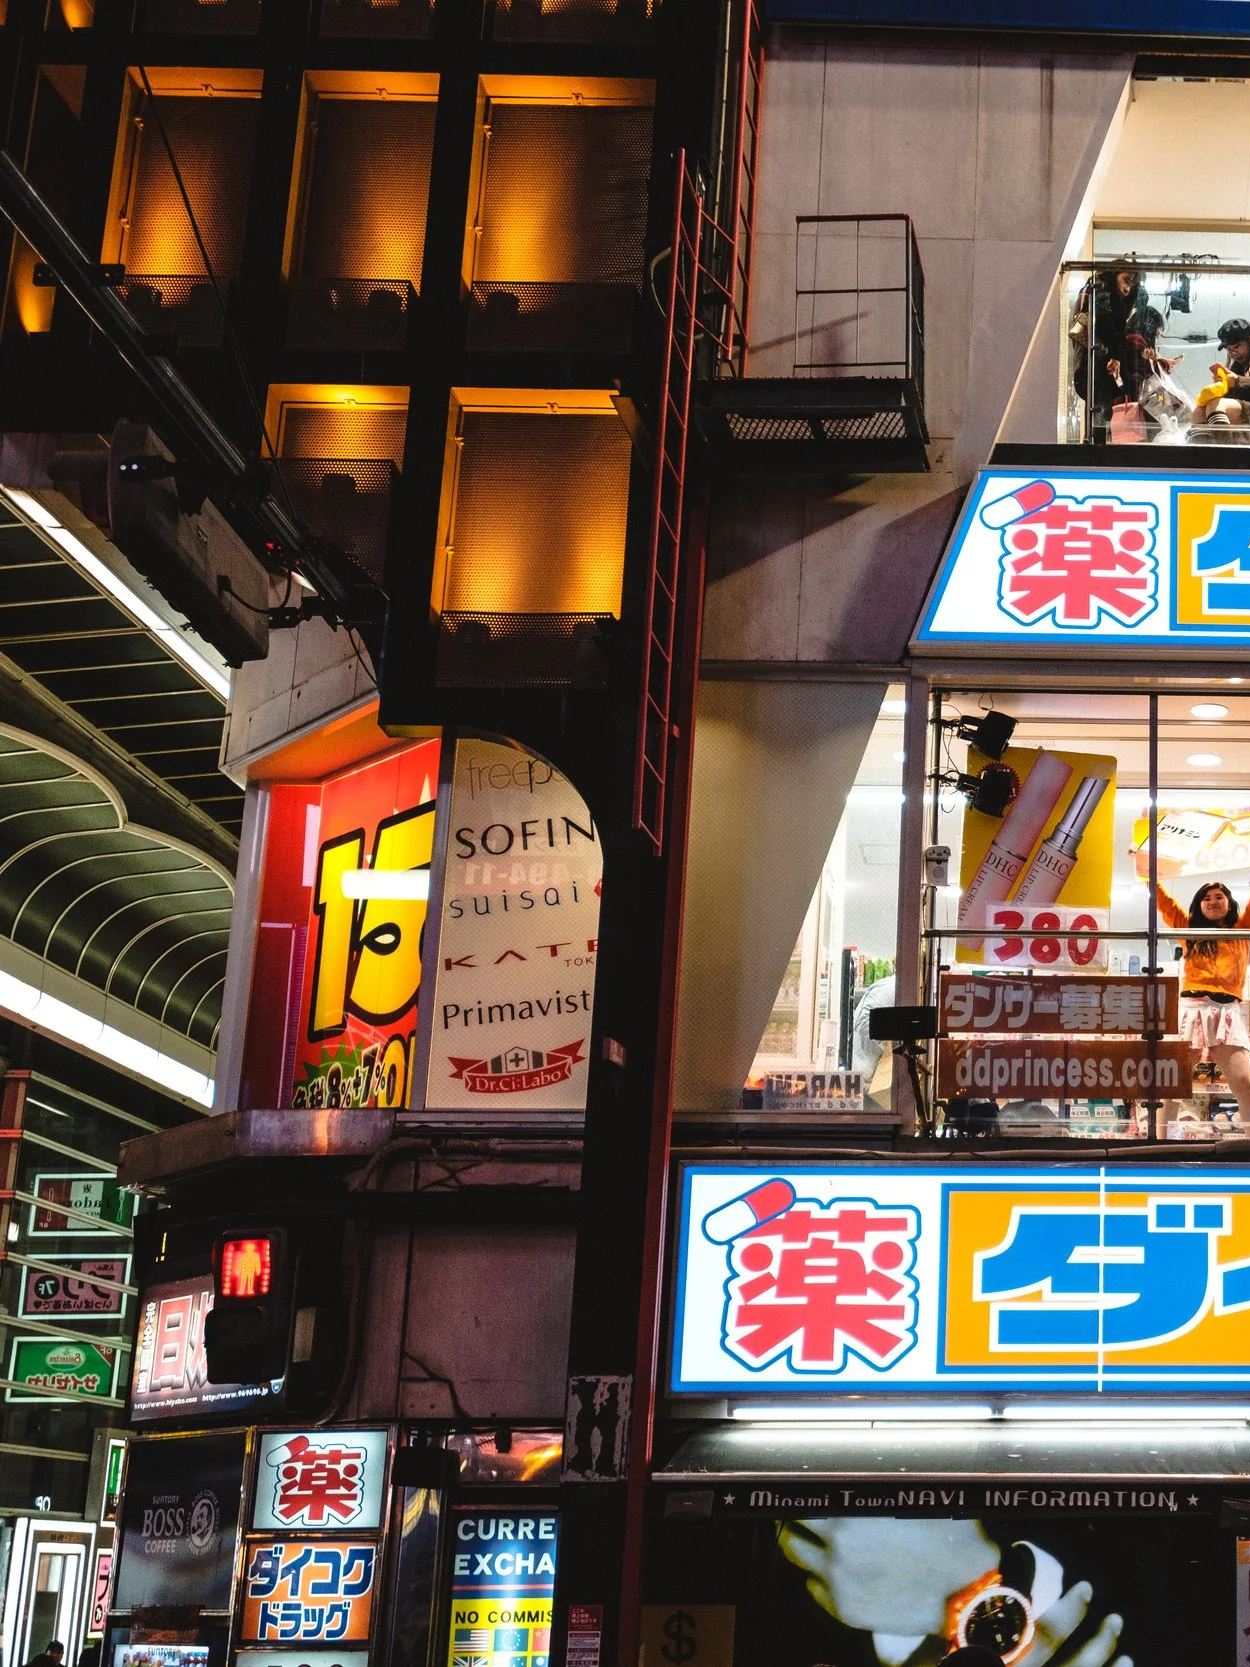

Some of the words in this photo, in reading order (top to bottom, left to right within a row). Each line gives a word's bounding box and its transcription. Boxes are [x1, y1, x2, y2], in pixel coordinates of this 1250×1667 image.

[1005, 499, 1152, 622] 薬
[976, 869, 989, 888] LIP
[984, 851, 1019, 878] DHC
[1027, 868, 1040, 886] LIP
[1036, 850, 1069, 877] DHC
[449, 881, 579, 918] suisai
[993, 910, 1099, 966] 380
[445, 938, 599, 971] KATE
[443, 990, 591, 1030] Primavist
[944, 982, 1167, 1031] ダンサー募集!!
[476, 1071, 562, 1091] Dr.Ci:Labo
[955, 1049, 1179, 1093] ddprincess.com
[731, 1205, 912, 1364] 薬
[277, 1443, 363, 1522] 薬
[750, 1490, 830, 1507] Minami
[984, 1489, 1176, 1508] INFORMATION
[141, 1507, 186, 1538] BOSS
[457, 1518, 556, 1541] CURRE
[144, 1539, 177, 1554] COFFEE
[248, 1545, 377, 1598] ダイコク
[454, 1552, 556, 1577] EXCHA
[257, 1600, 351, 1641] ドラッグ
[455, 1610, 480, 1625] NO
